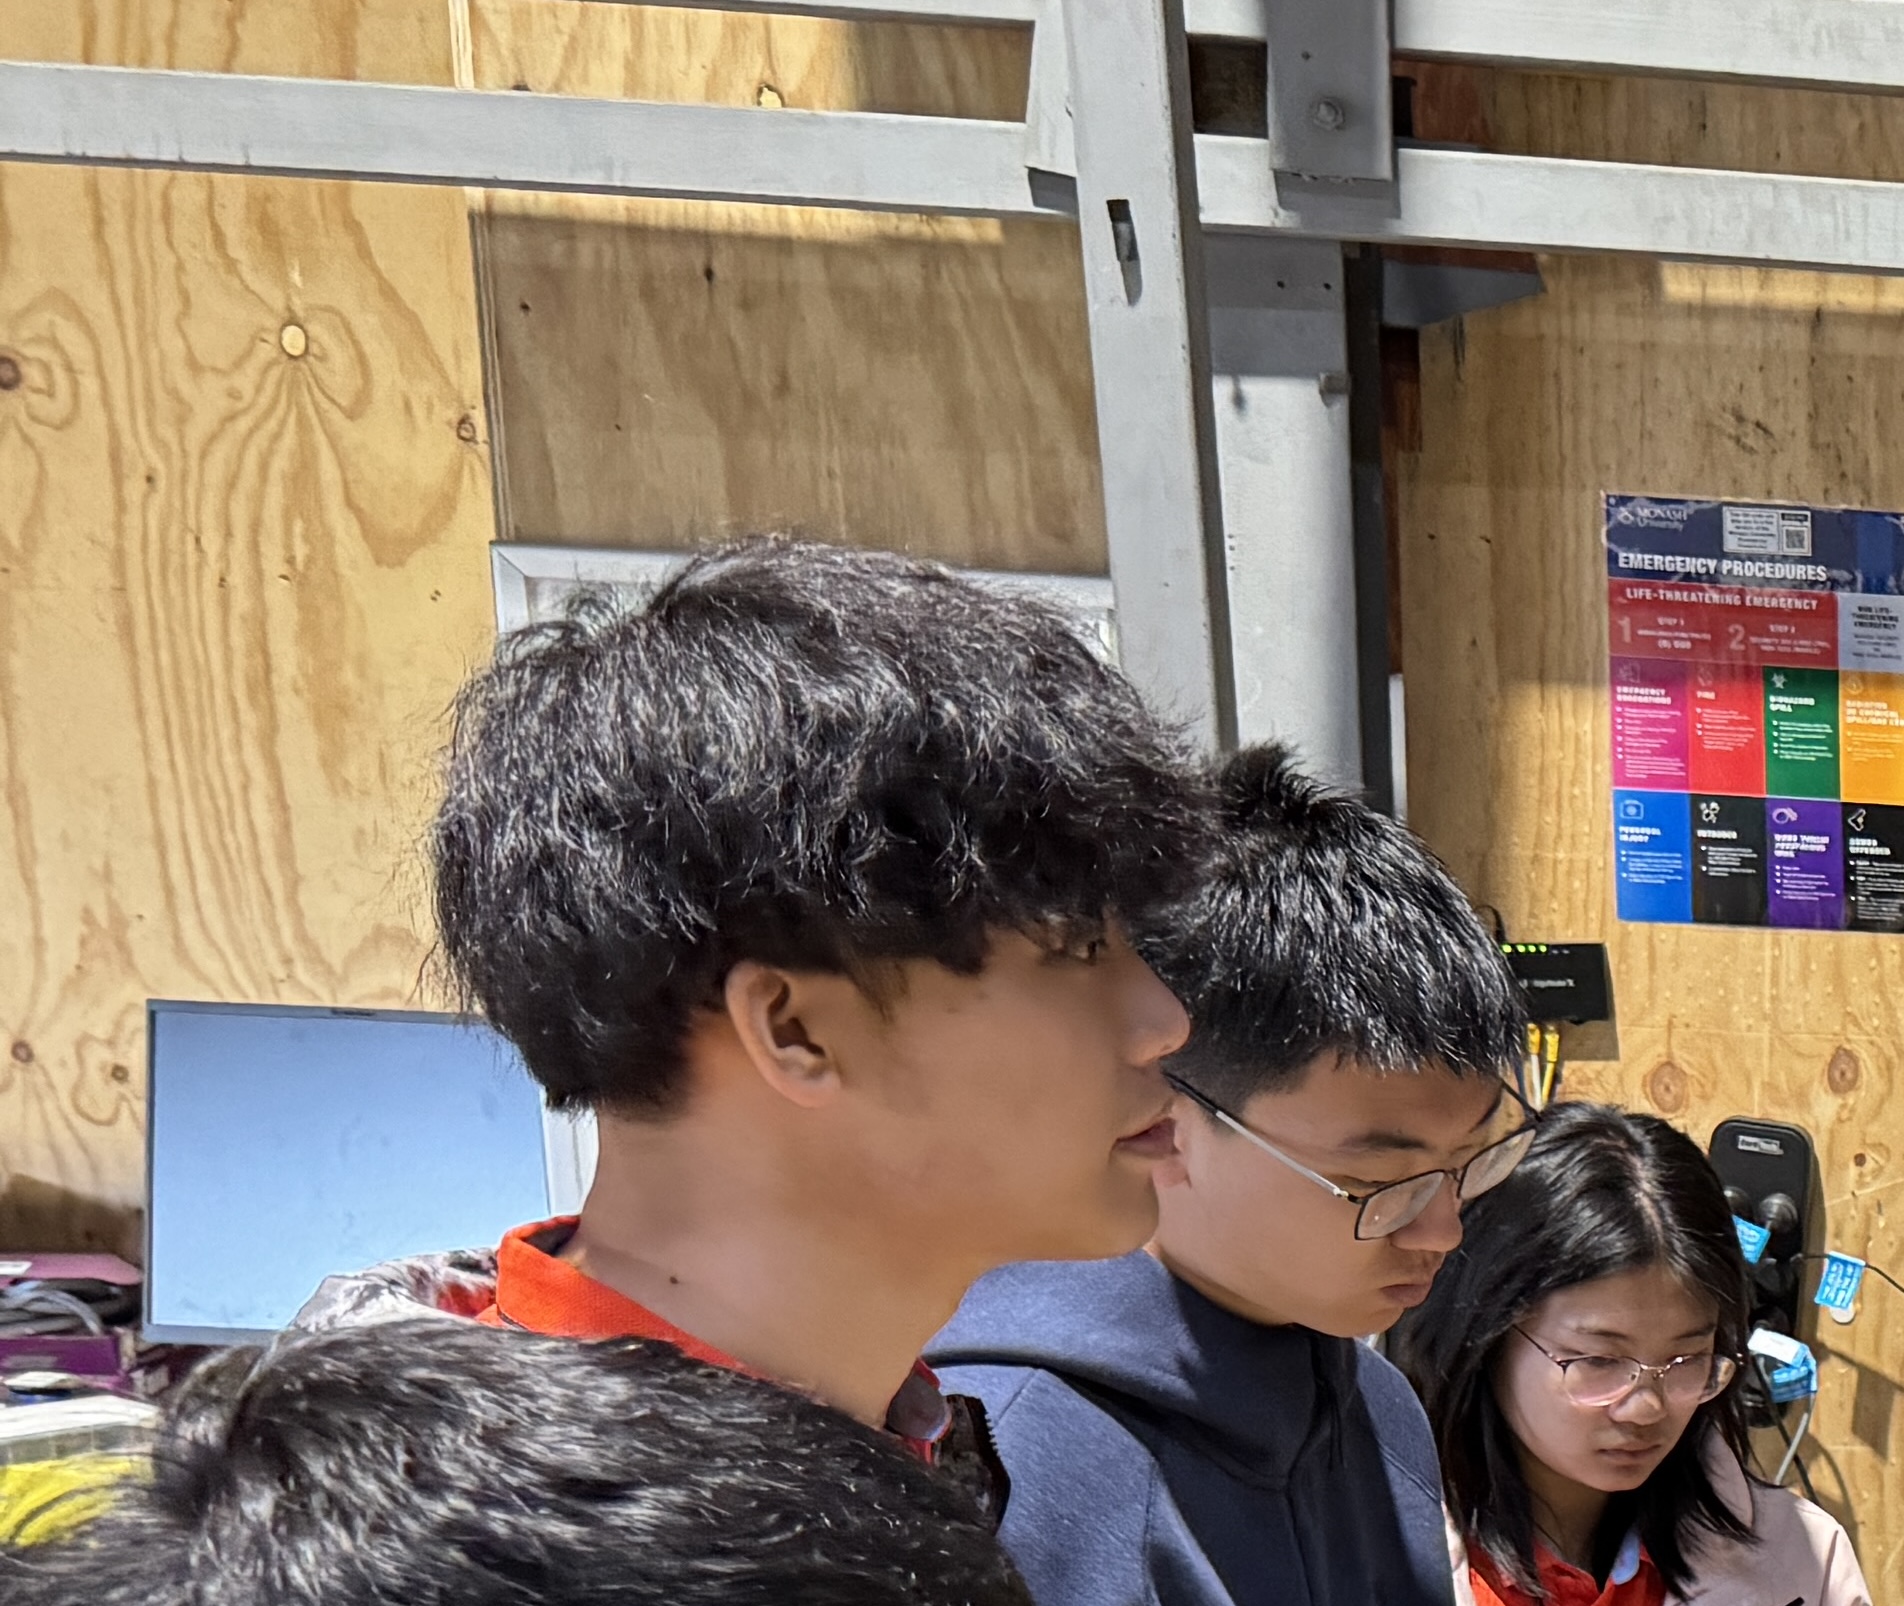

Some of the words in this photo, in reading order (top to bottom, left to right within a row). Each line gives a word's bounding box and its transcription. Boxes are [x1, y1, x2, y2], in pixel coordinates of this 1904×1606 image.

[1618, 552, 1718, 576] EMERGENCY
[1722, 559, 1828, 582] PROCEDURES
[1625, 587, 1742, 606] LIFE-THREATENING
[1745, 594, 1818, 611] EMERGENCY
[1617, 616, 1632, 643] 1
[1728, 623, 1747, 650] 2
